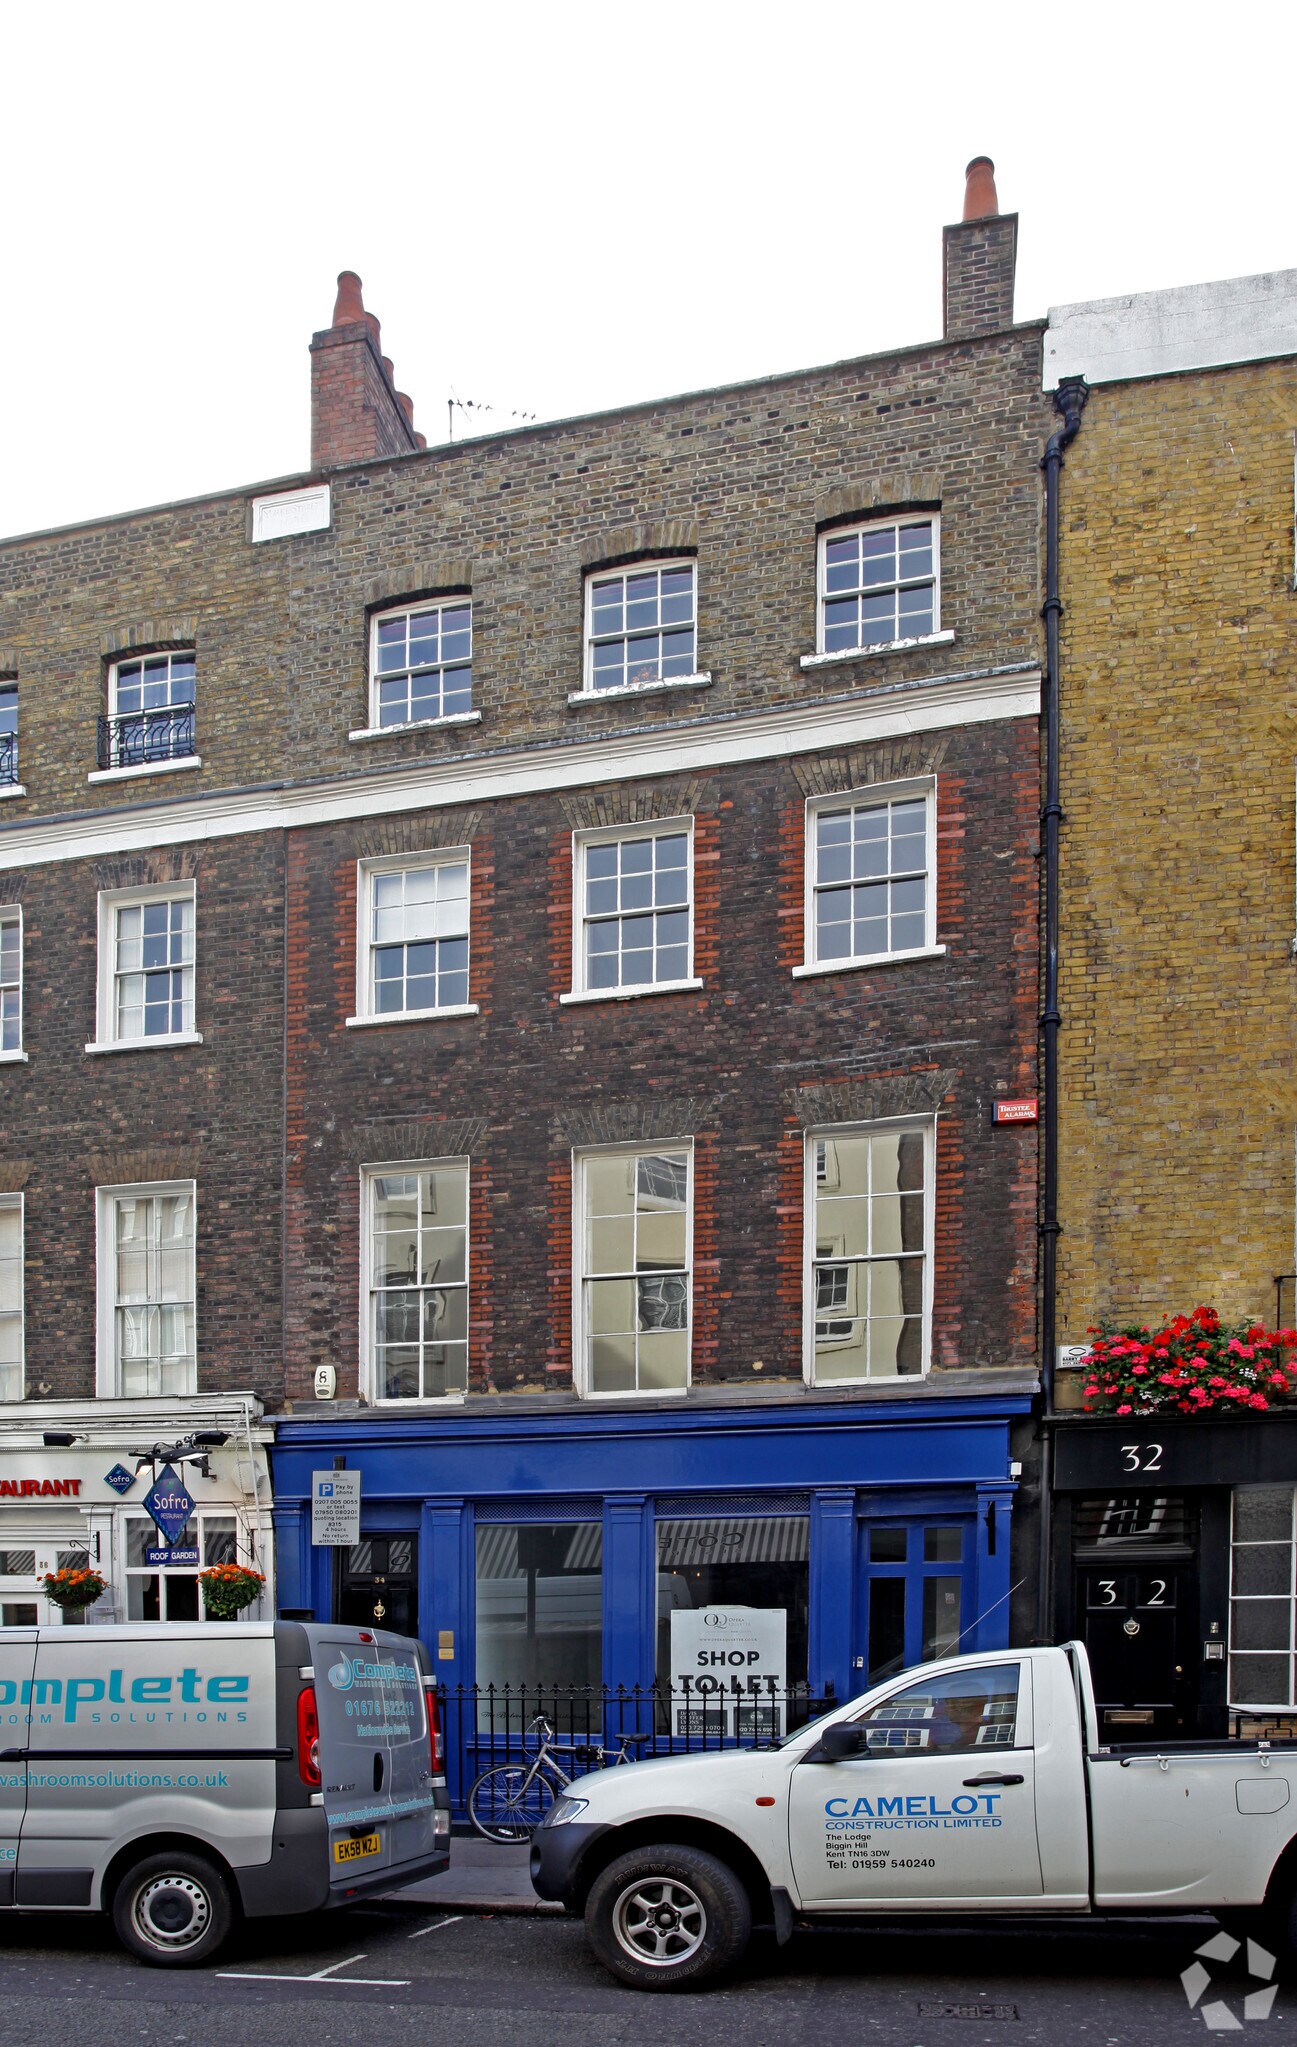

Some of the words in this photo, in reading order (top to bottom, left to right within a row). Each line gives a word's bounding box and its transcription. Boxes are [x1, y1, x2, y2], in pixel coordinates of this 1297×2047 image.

[1120, 1444, 1163, 1472] 32
[0, 1480, 82, 1496] AURANT
[322, 1485, 331, 1495] P
[154, 1494, 188, 1509] Sofra
[697, 1651, 760, 1666] SHOP
[353, 1659, 416, 1688] Complete
[678, 1675, 718, 1694] TO
[731, 1675, 779, 1694] LET
[345, 1700, 381, 1716] 01676
[0, 1714, 52, 1724] OOM
[92, 1712, 247, 1722] SOLUTIONS
[327, 1784, 355, 1793] RENAULT
[824, 1794, 1001, 1817] CAMELOT
[825, 1819, 939, 1830] CONSTRUCTION
[944, 1818, 1002, 1828] LIMITED
[338, 1842, 360, 1859] EK58
[827, 1860, 847, 1869] Tel:
[852, 1860, 886, 1869] 01959
[891, 1859, 935, 1868] 540240
[615, 1864, 688, 1885] RUNWAY
